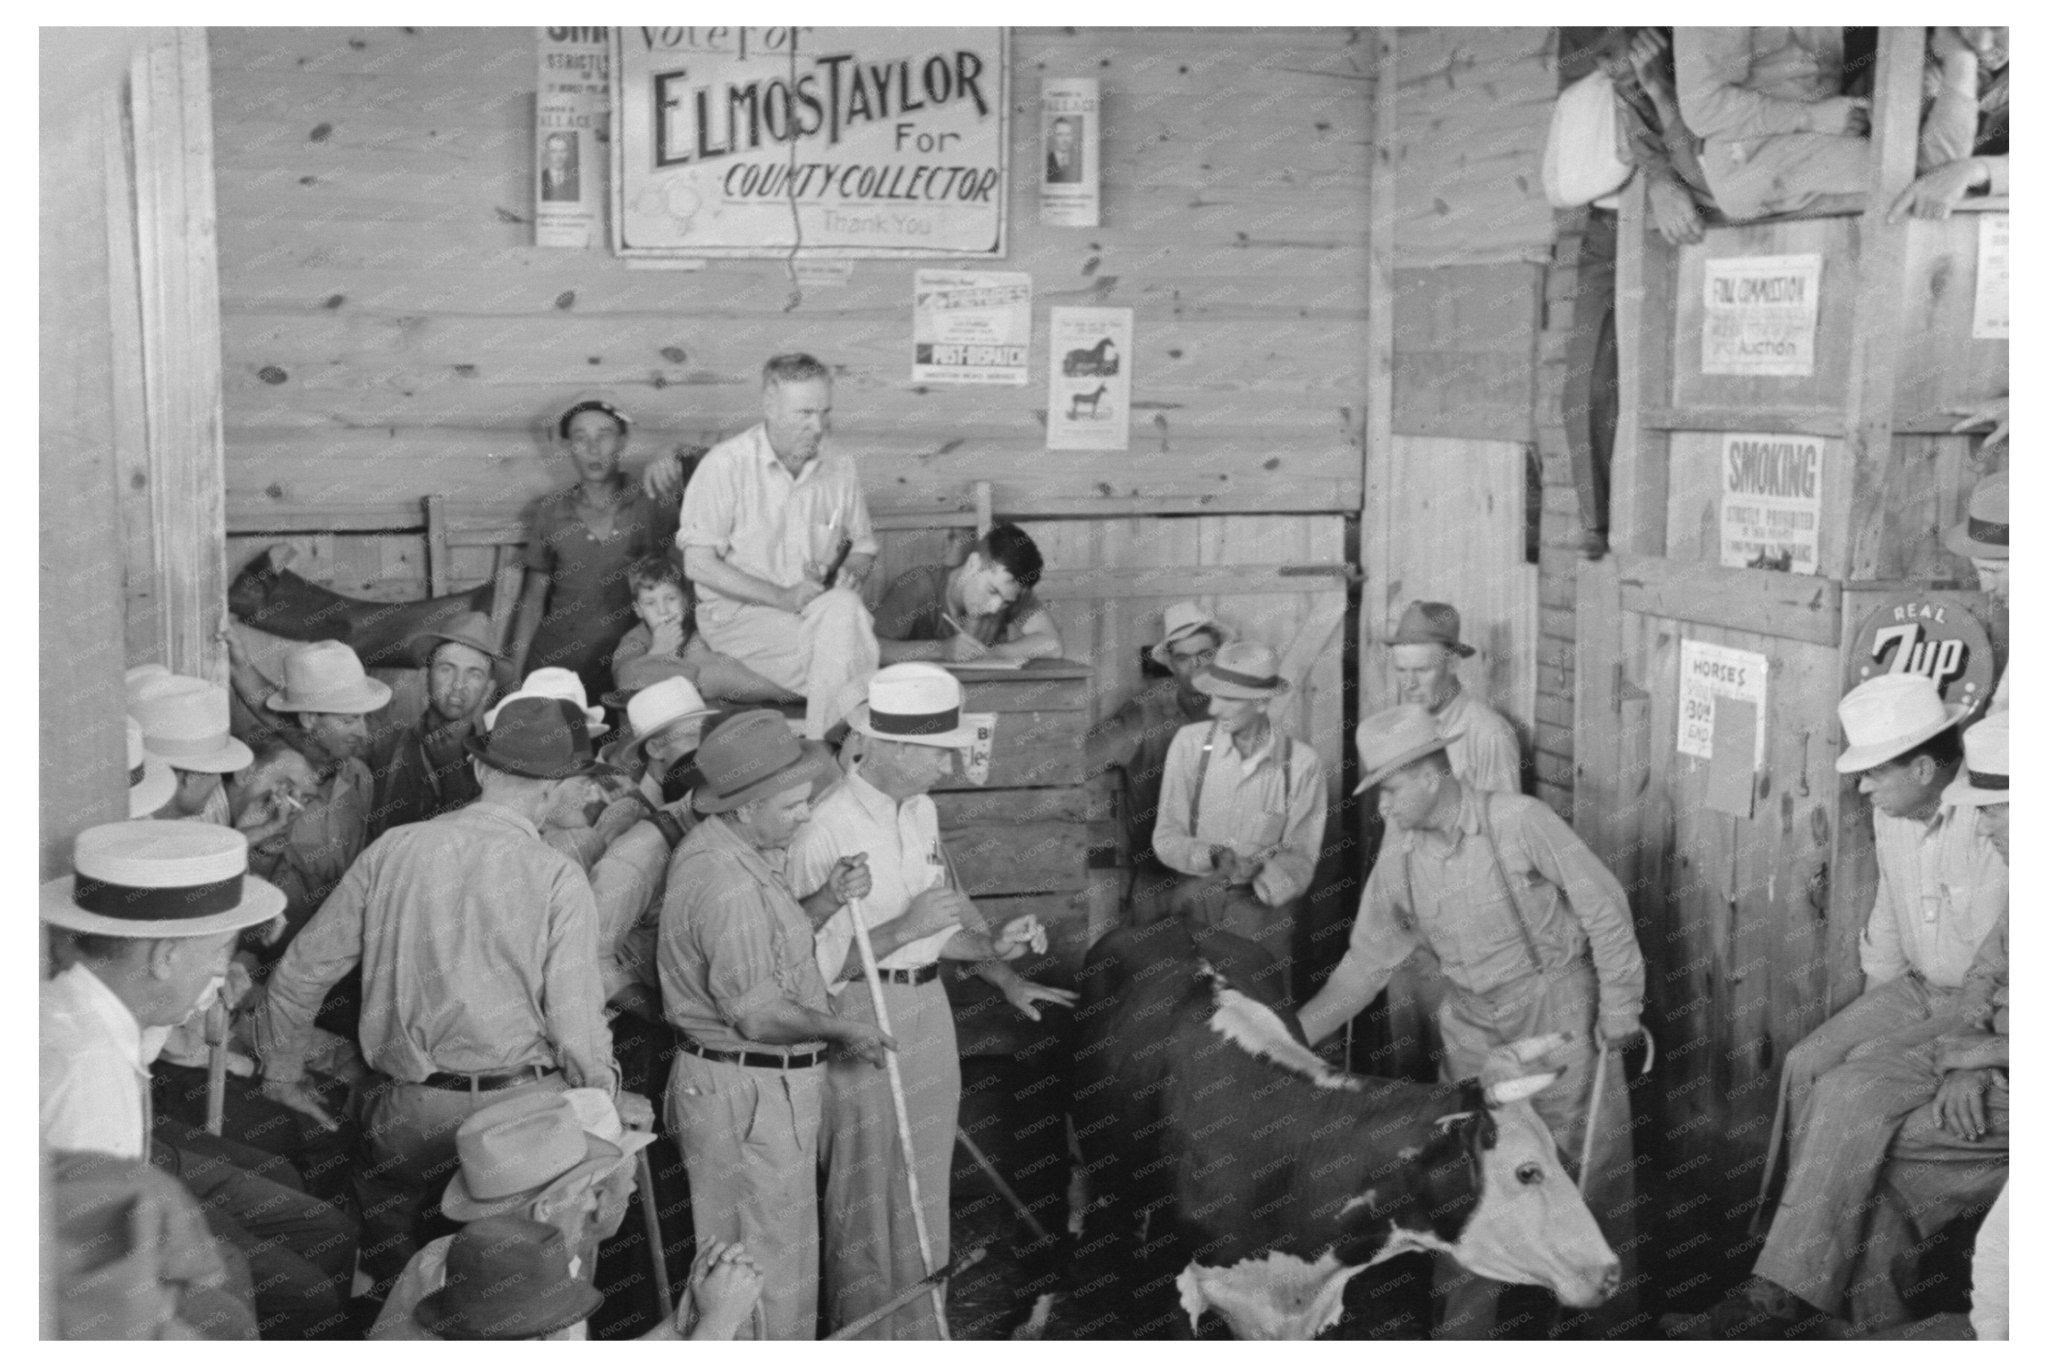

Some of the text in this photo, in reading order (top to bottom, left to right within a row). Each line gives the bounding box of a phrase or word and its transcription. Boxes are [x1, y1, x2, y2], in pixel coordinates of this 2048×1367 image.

[655, 51, 987, 168] ELMOS TAYLOR
[897, 122, 960, 152] For
[839, 164, 998, 201] COLLECTOR
[823, 209, 932, 235] Thank You
[1729, 441, 1816, 498] SMOKING
[1894, 603, 1946, 624] REAL
[1693, 659, 1746, 687] HORSES
